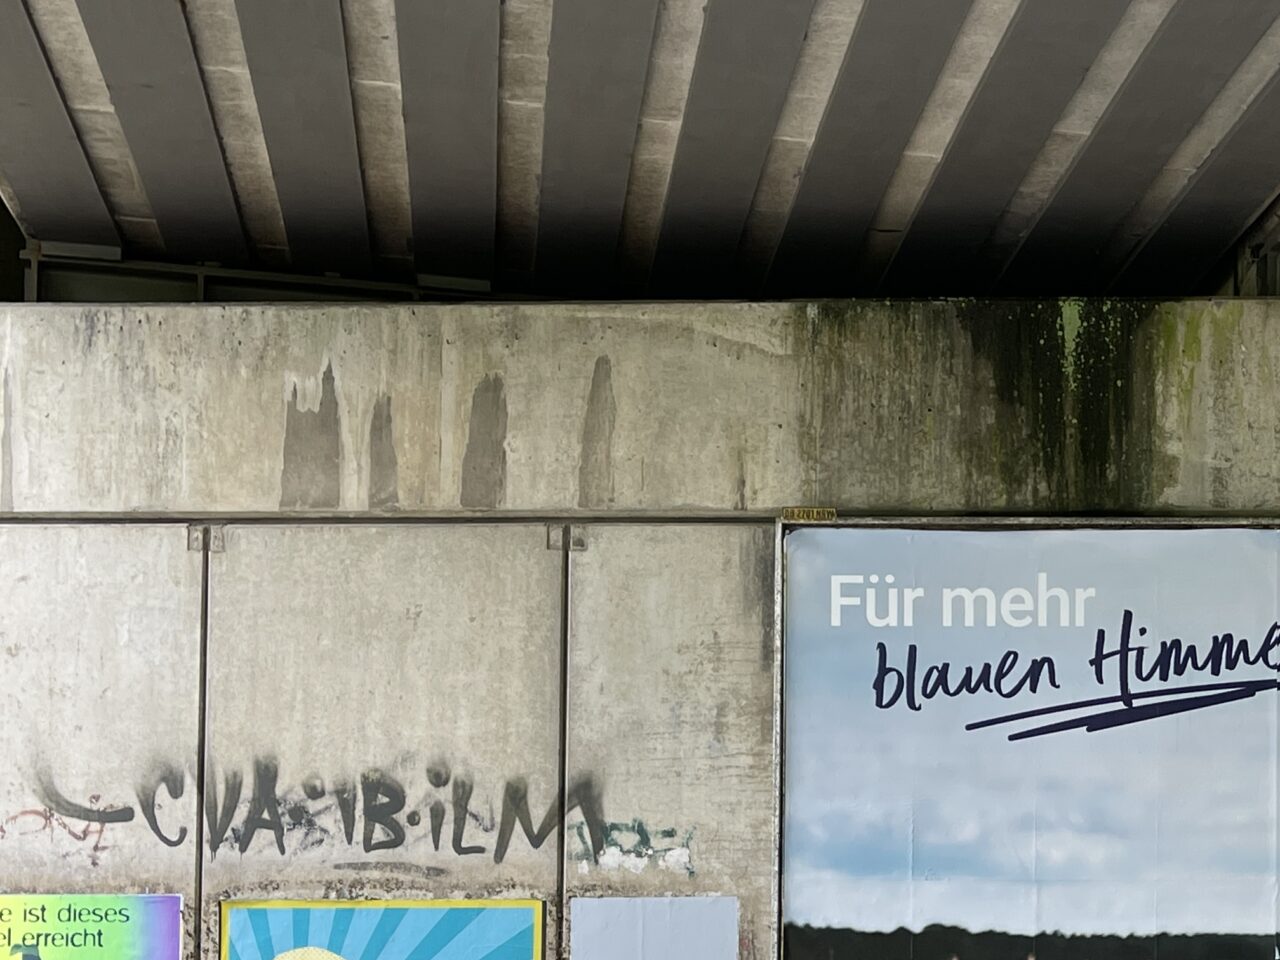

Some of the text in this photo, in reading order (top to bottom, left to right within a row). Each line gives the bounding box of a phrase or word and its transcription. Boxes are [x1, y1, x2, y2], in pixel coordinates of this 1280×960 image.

[829, 571, 1097, 628] Für mehr
[872, 641, 1061, 711] blauen
[22, 904, 47, 923] ist
[57, 904, 130, 923] dieses
[21, 929, 104, 948] erreicht
